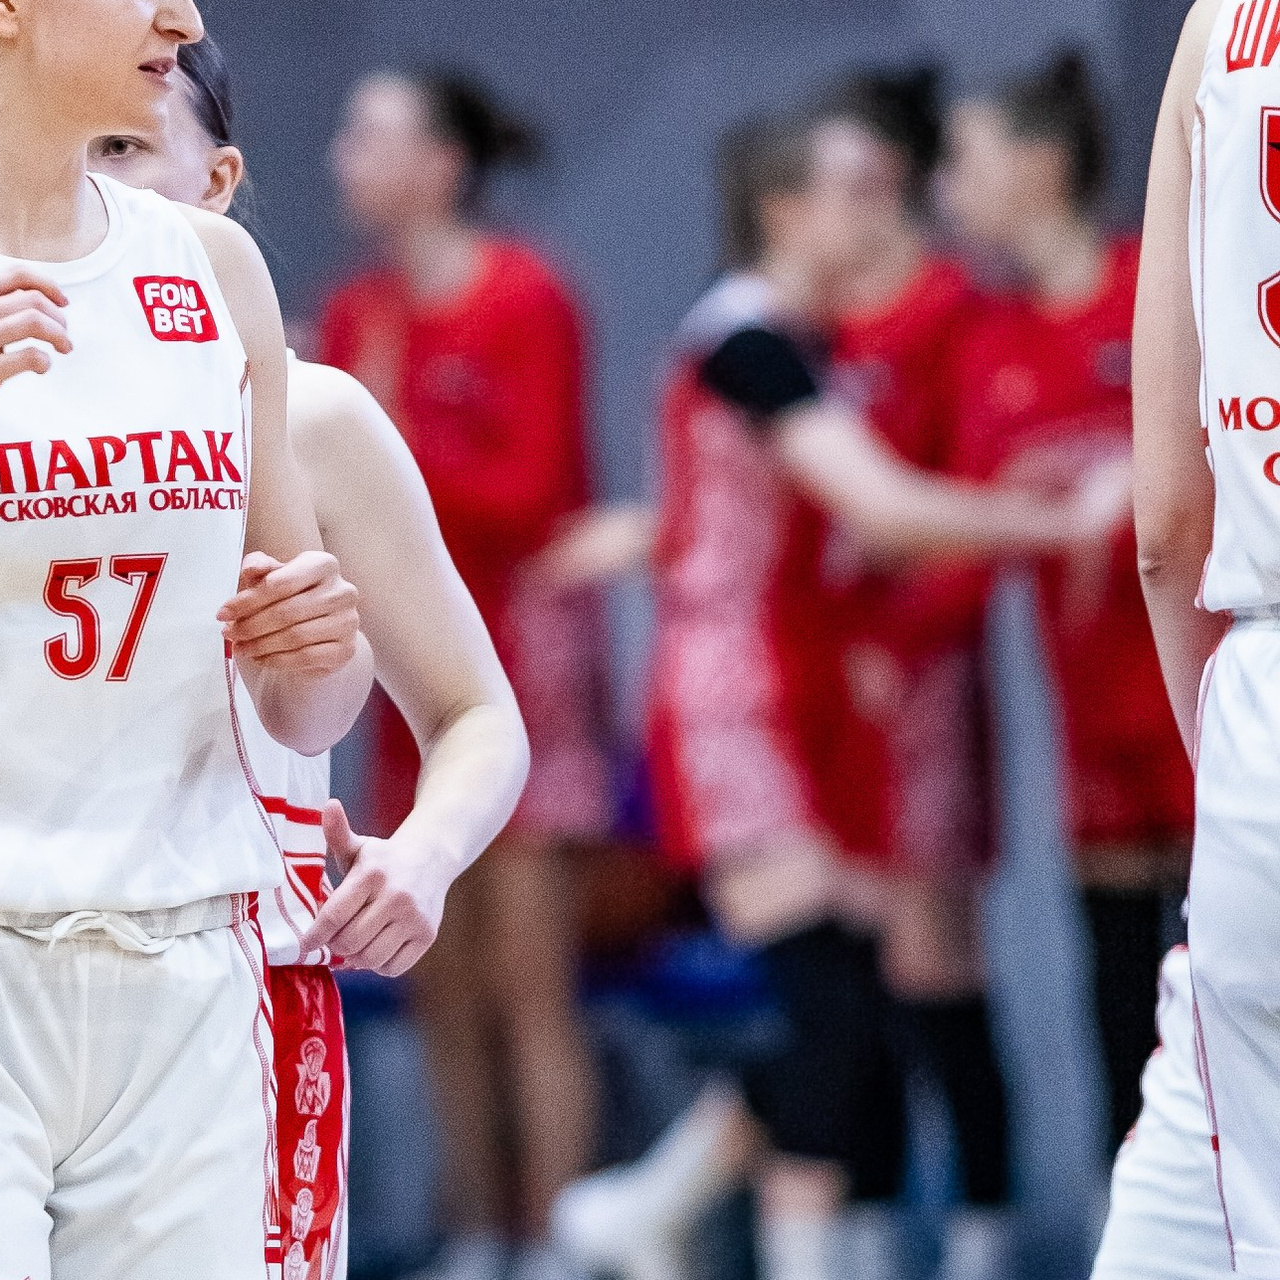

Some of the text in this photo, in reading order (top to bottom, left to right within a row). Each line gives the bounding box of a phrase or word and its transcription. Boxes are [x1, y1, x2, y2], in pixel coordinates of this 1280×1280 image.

[144, 282, 198, 308] FON
[153, 307, 207, 334] BET
[43, 552, 169, 682] 57
